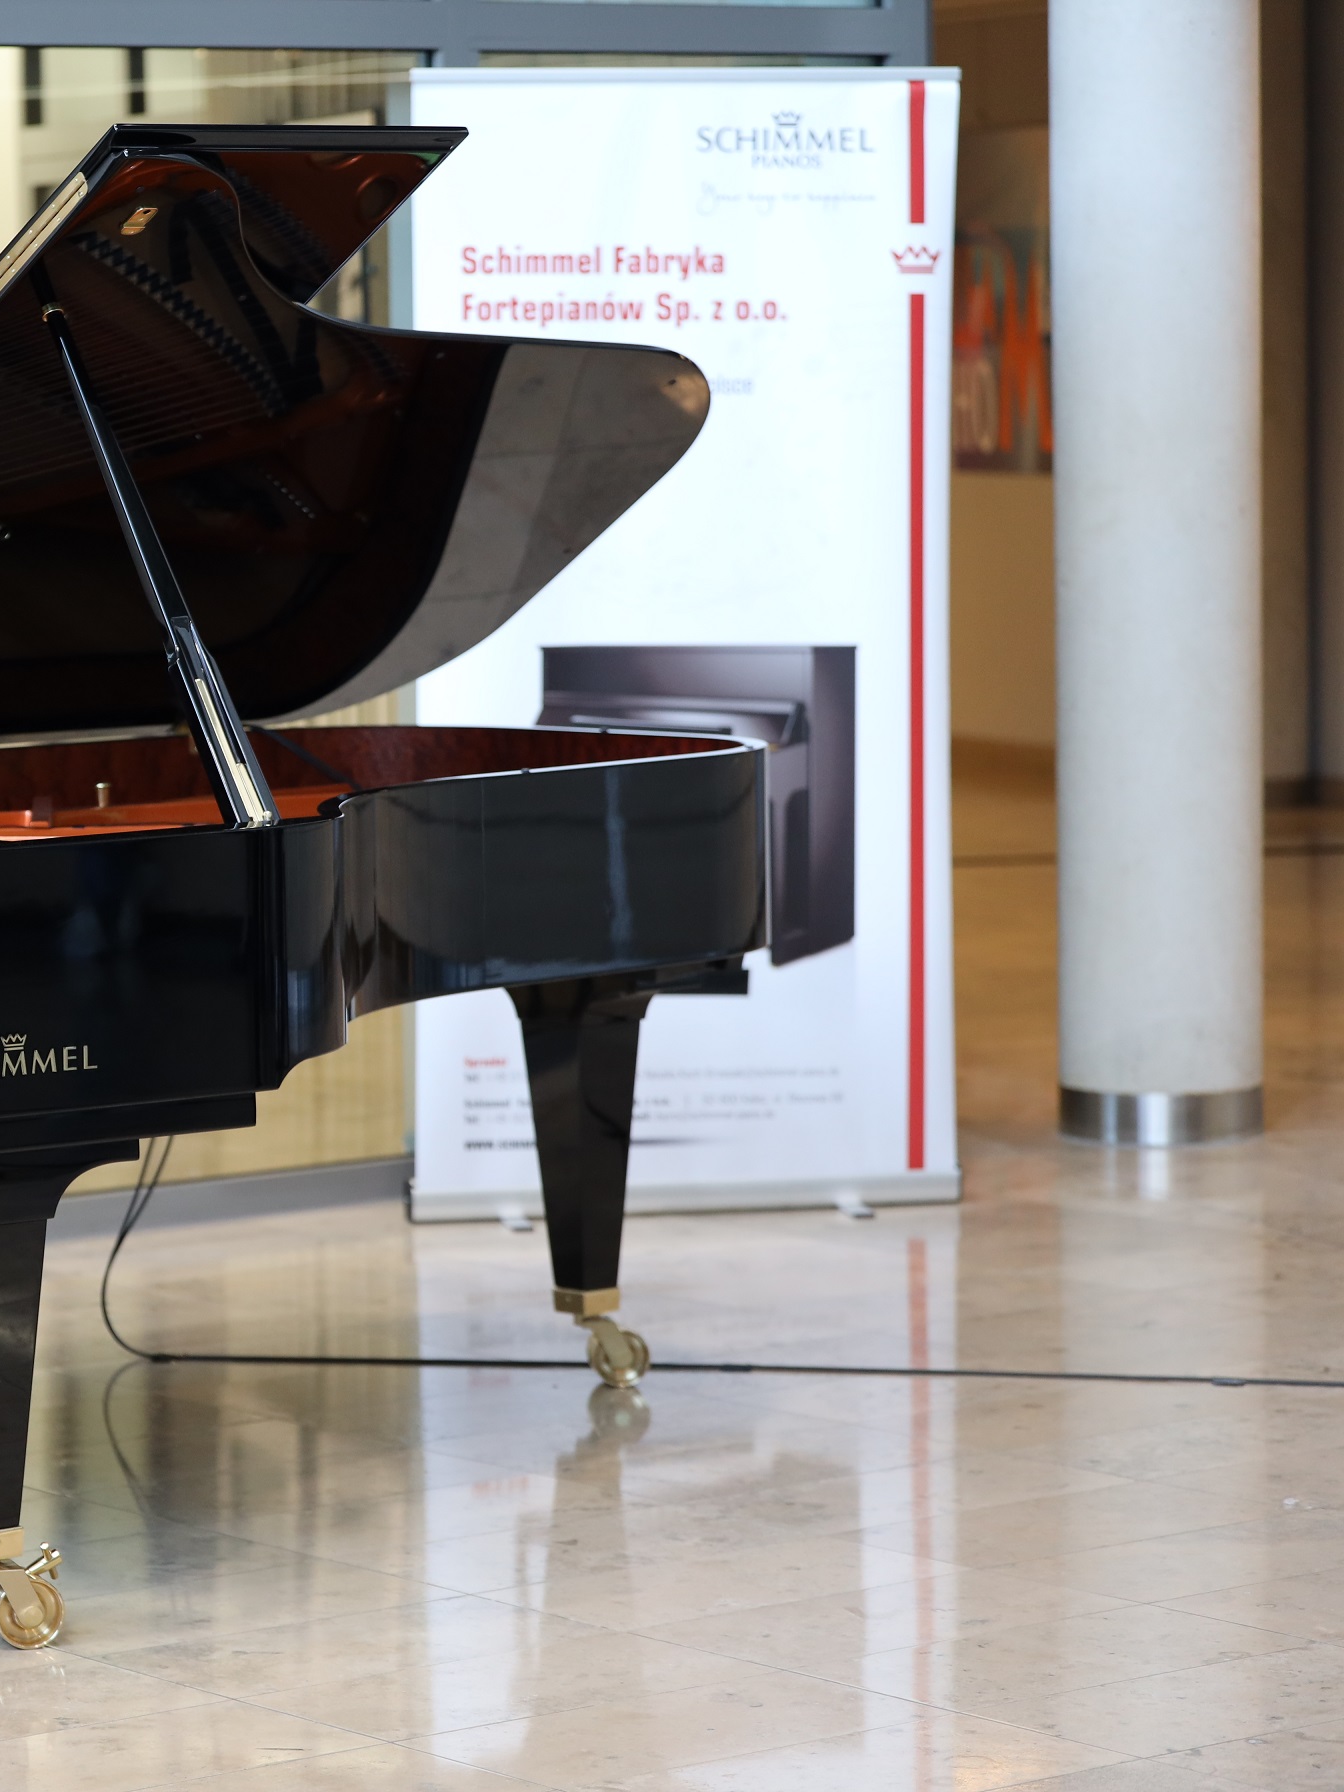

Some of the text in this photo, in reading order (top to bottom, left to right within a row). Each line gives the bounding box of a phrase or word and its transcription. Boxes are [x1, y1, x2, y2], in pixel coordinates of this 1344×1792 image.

[696, 126, 876, 153] SCHIMMEL
[751, 154, 823, 169] PIANOS
[462, 245, 726, 280] Schimmel Fabryka
[462, 292, 788, 328] Fortepianów Sp. z o.o.
